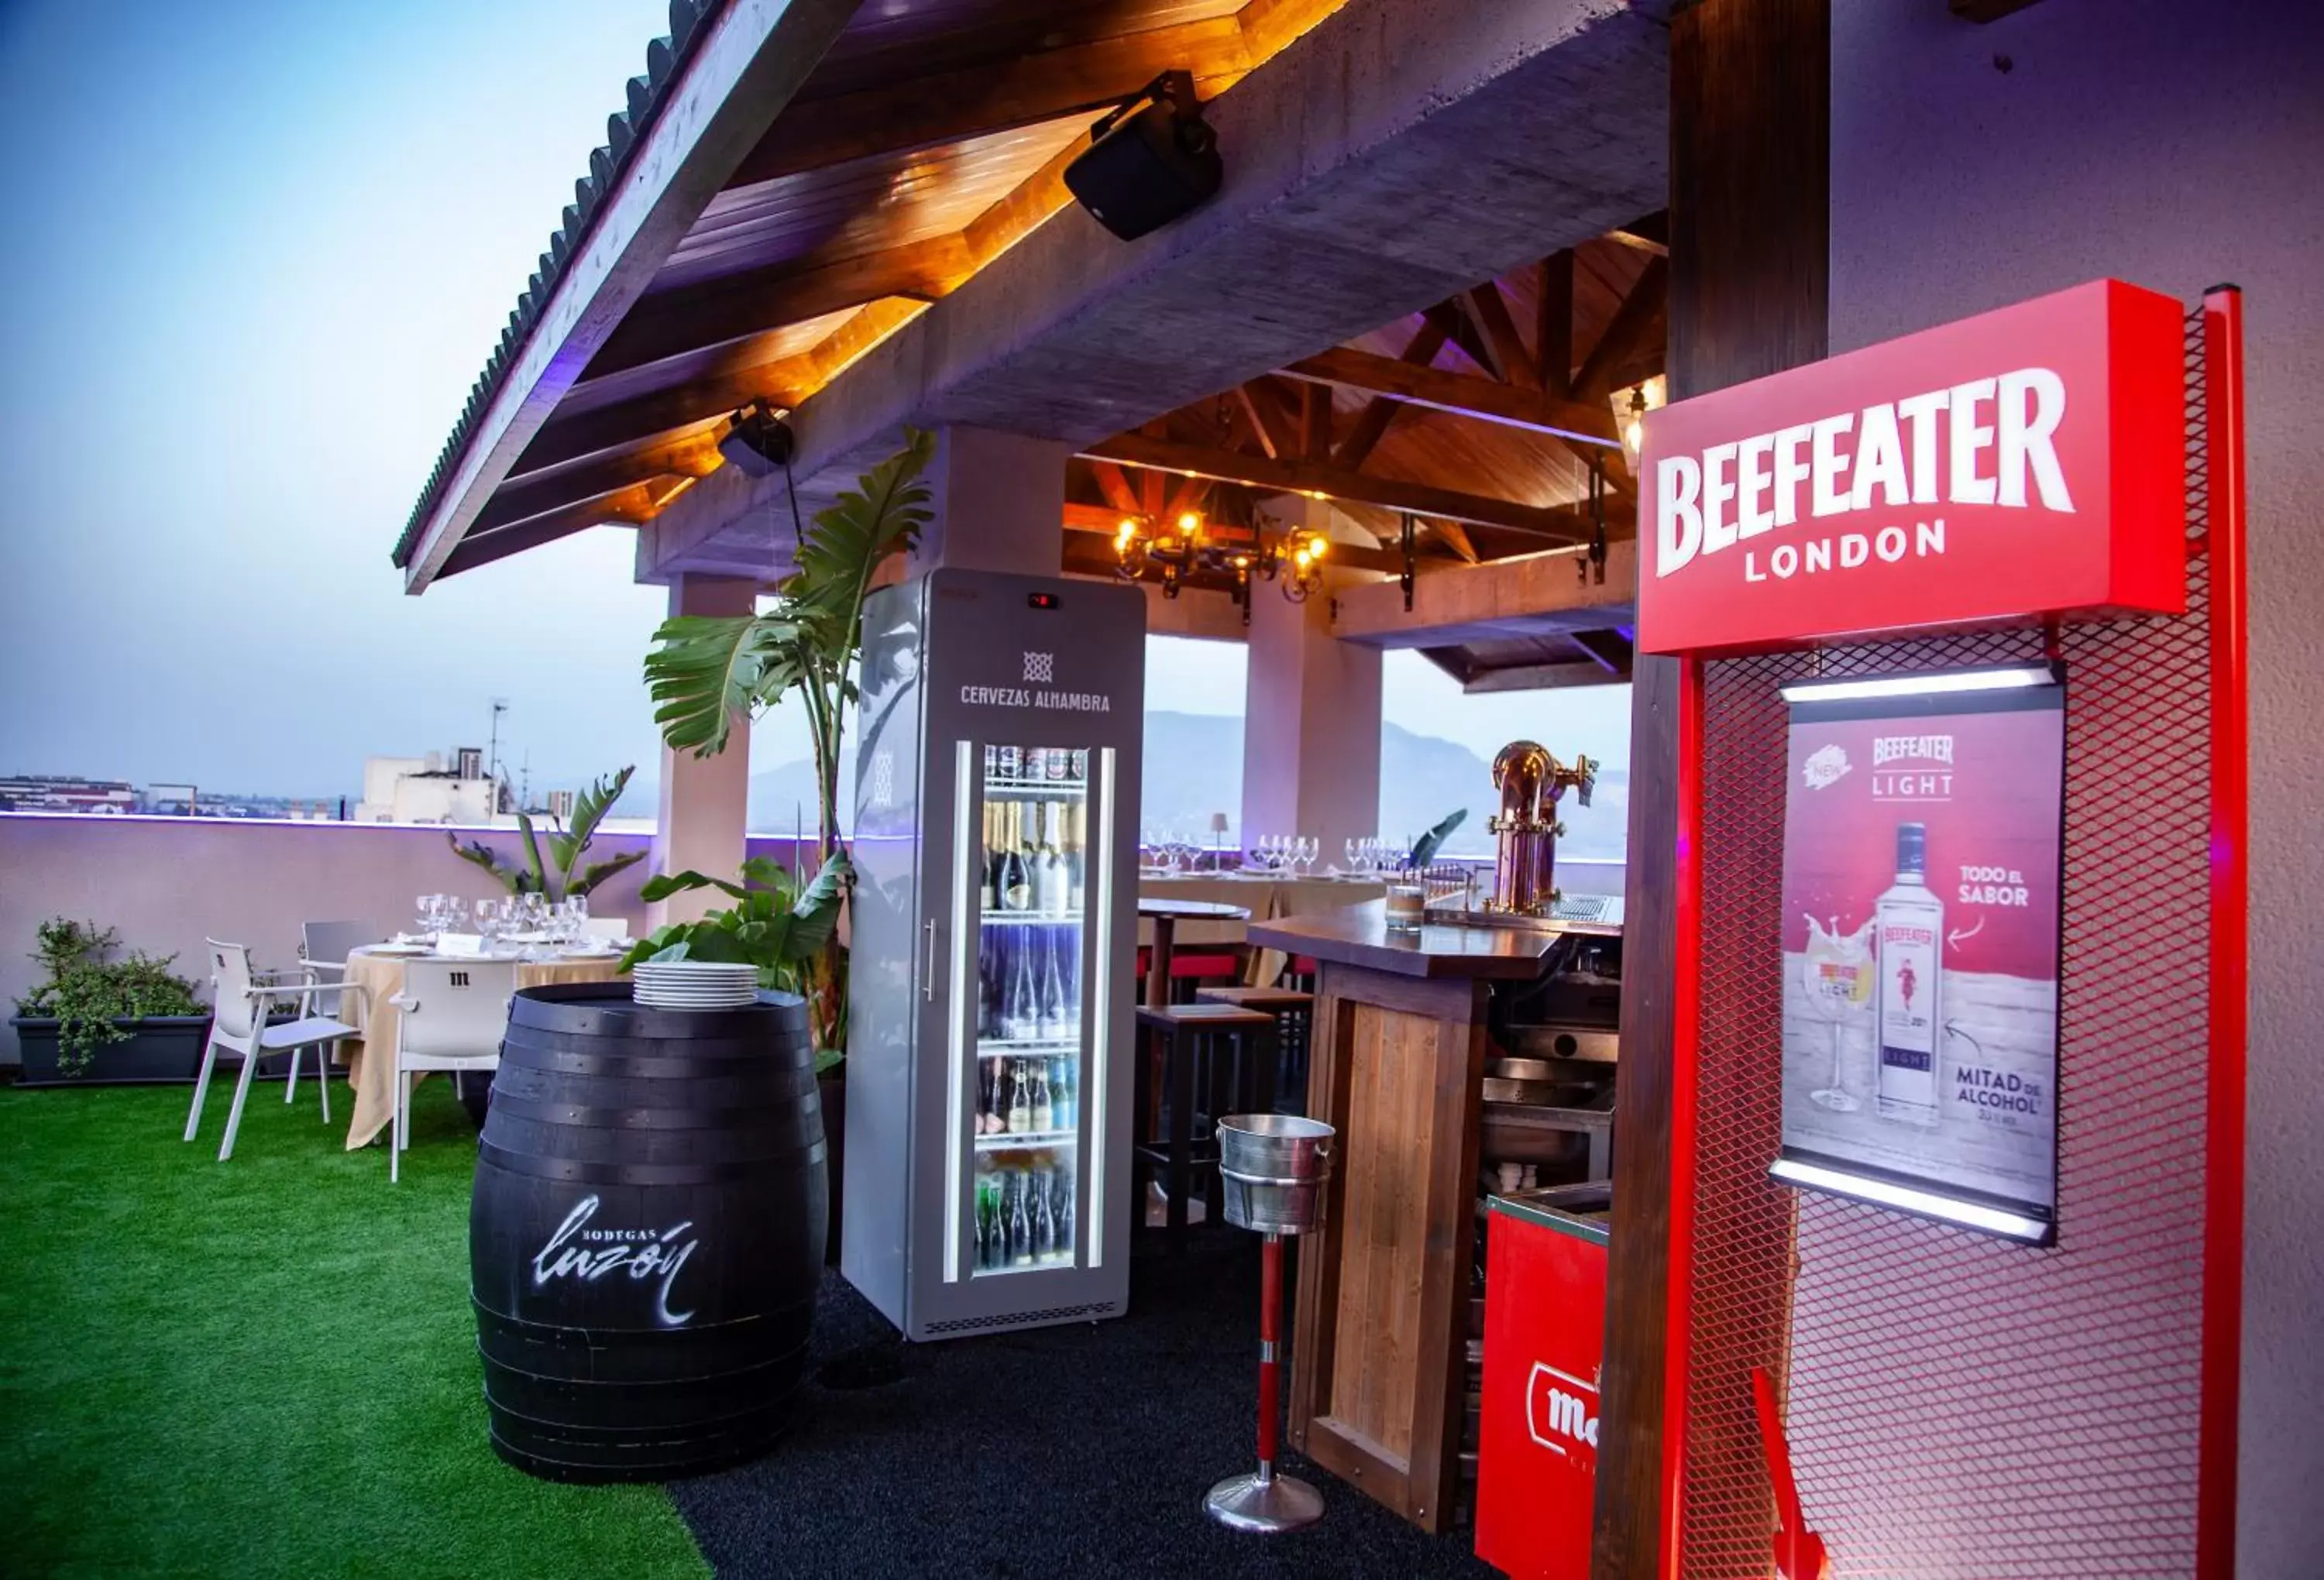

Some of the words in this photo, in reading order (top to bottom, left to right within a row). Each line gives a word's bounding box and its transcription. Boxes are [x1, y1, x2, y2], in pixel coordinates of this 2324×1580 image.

[1655, 367, 2076, 578] BEEFEATER
[1745, 518, 1945, 582] LONDON
[961, 685, 1030, 708] CERVEZAS
[1034, 690, 1110, 713] ALHAMBRA
[1873, 734, 1954, 767] BEEFEATER
[1872, 775, 1953, 795] LIGHT
[1959, 864, 2006, 883] TODO
[2008, 870, 2024, 884] EL
[1958, 883, 2029, 907] SABOR
[1956, 1066, 2021, 1092] MITAD
[1958, 1087, 2039, 1115] ALCOHOL
[583, 1228, 657, 1241] BODEGAS
